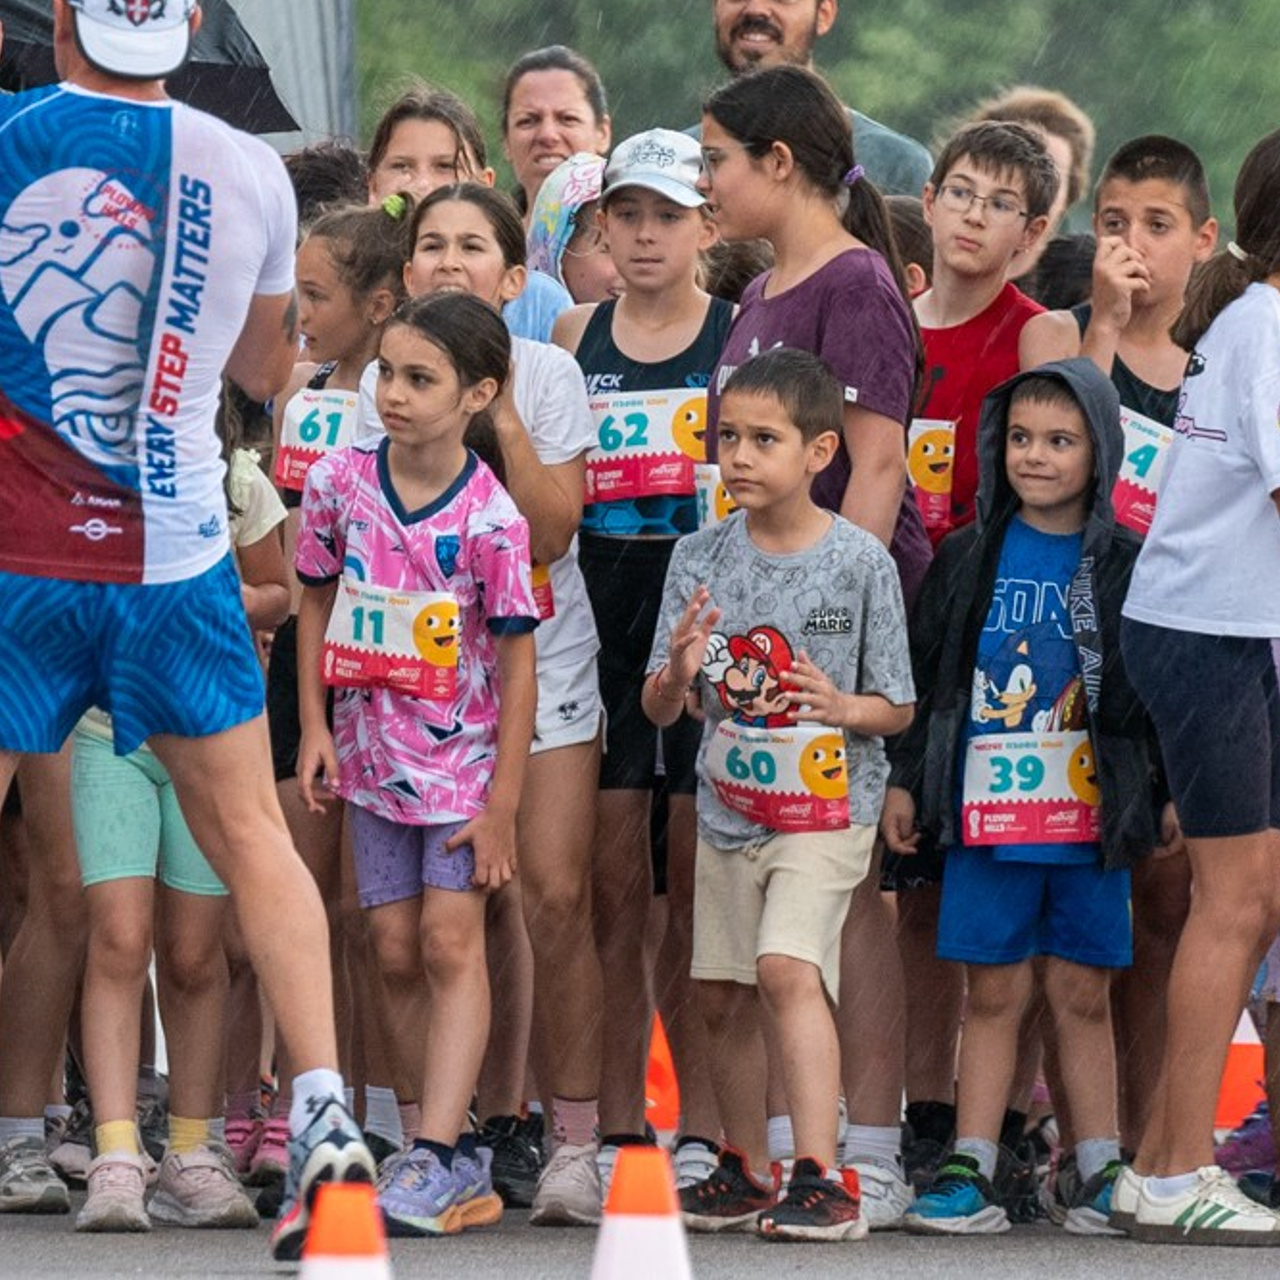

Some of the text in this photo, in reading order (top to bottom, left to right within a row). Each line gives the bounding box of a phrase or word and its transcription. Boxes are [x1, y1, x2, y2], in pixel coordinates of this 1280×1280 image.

[139, 174, 214, 499] EVERY STEP MATTERS
[299, 408, 342, 446] 61
[598, 412, 648, 451] 62
[810, 607, 848, 618] SUPER
[1071, 555, 1098, 632] NIKE
[351, 606, 384, 644] 11
[804, 619, 851, 631] MARIO
[726, 745, 776, 784] 60
[988, 754, 1045, 794] 39
